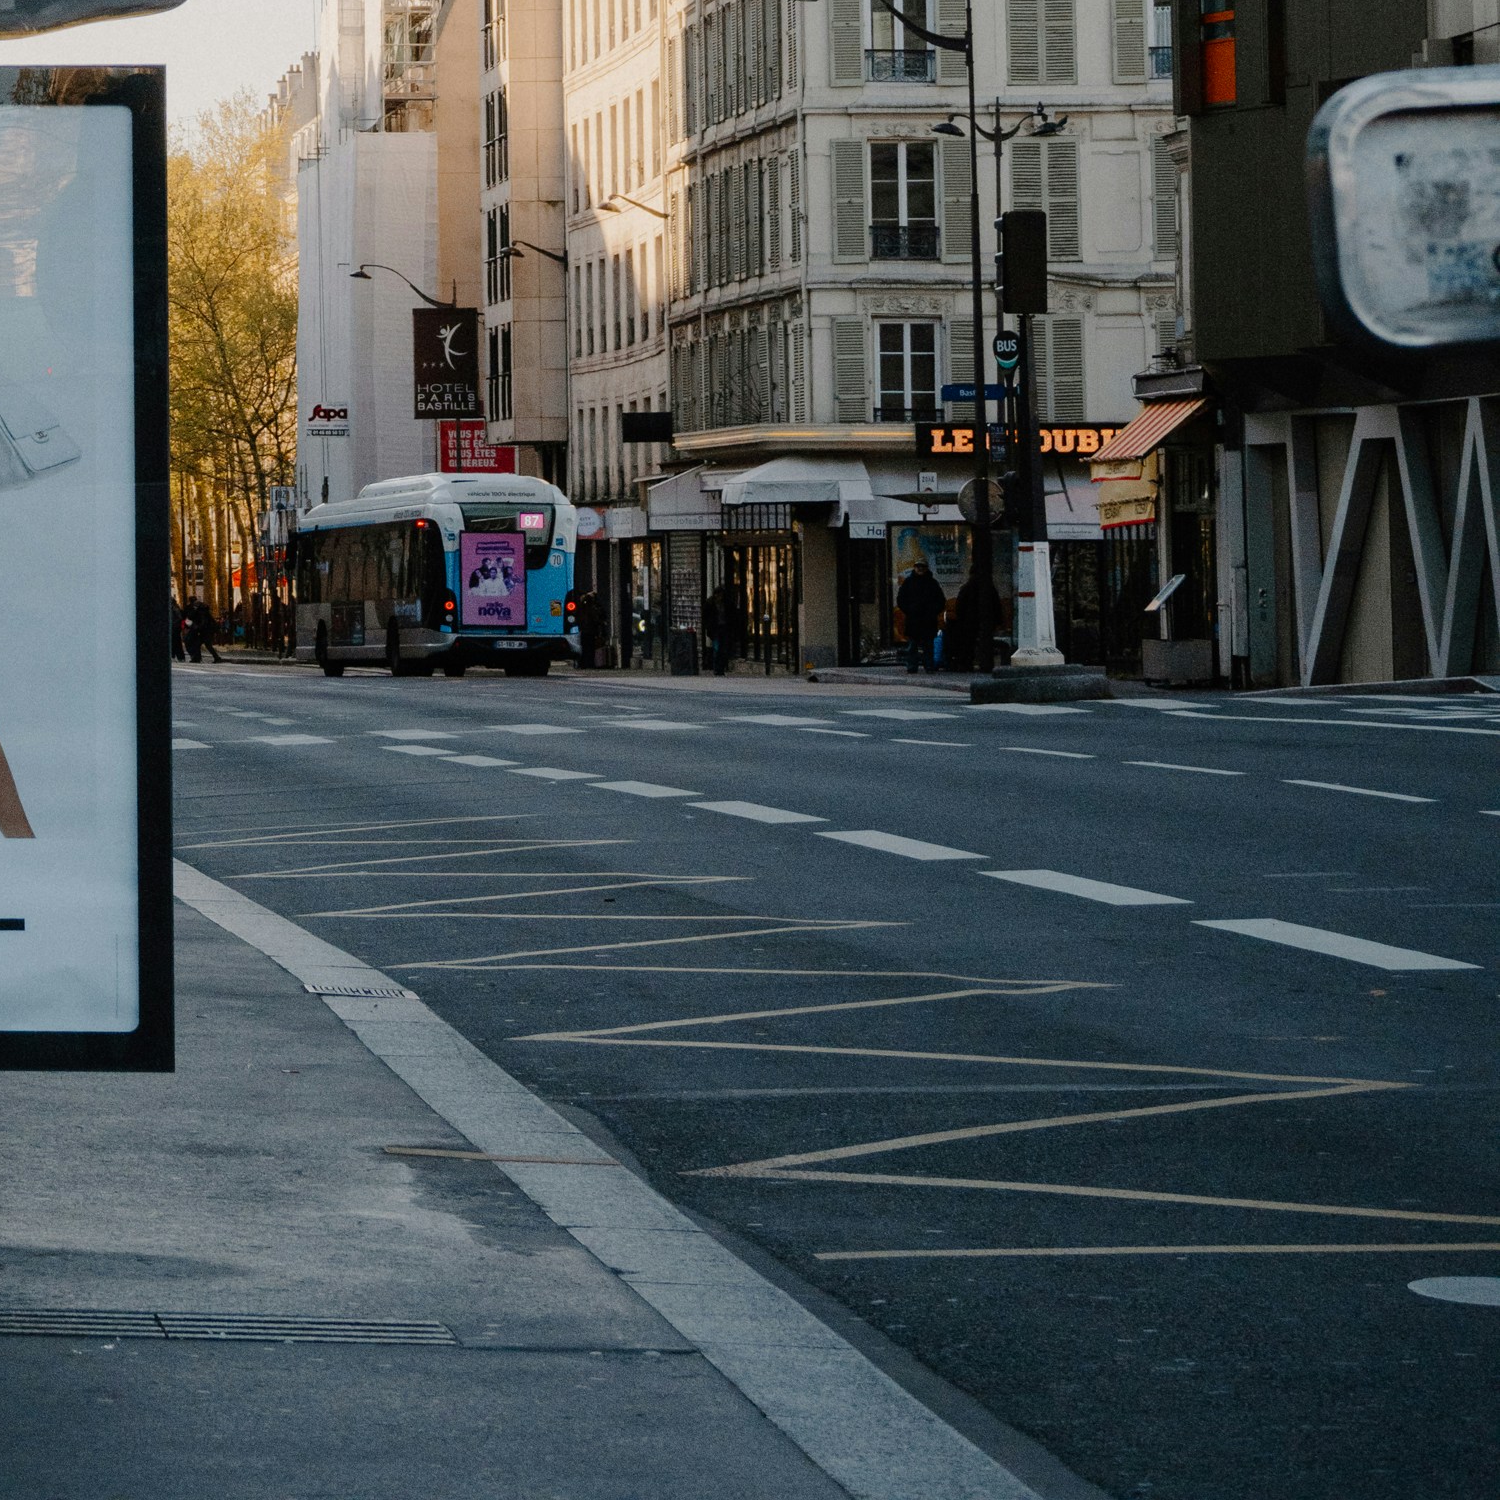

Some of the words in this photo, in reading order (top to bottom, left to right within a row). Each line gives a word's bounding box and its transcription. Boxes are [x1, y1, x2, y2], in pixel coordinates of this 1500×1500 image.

[996, 339, 1017, 352] BUS
[417, 383, 475, 393] HOTEL
[417, 393, 476, 401] PARIS
[417, 402, 476, 411] BASTILLE
[931, 429, 974, 453] LE
[524, 515, 539, 527] 87
[552, 554, 562, 566] 70
[478, 606, 511, 616] nova
